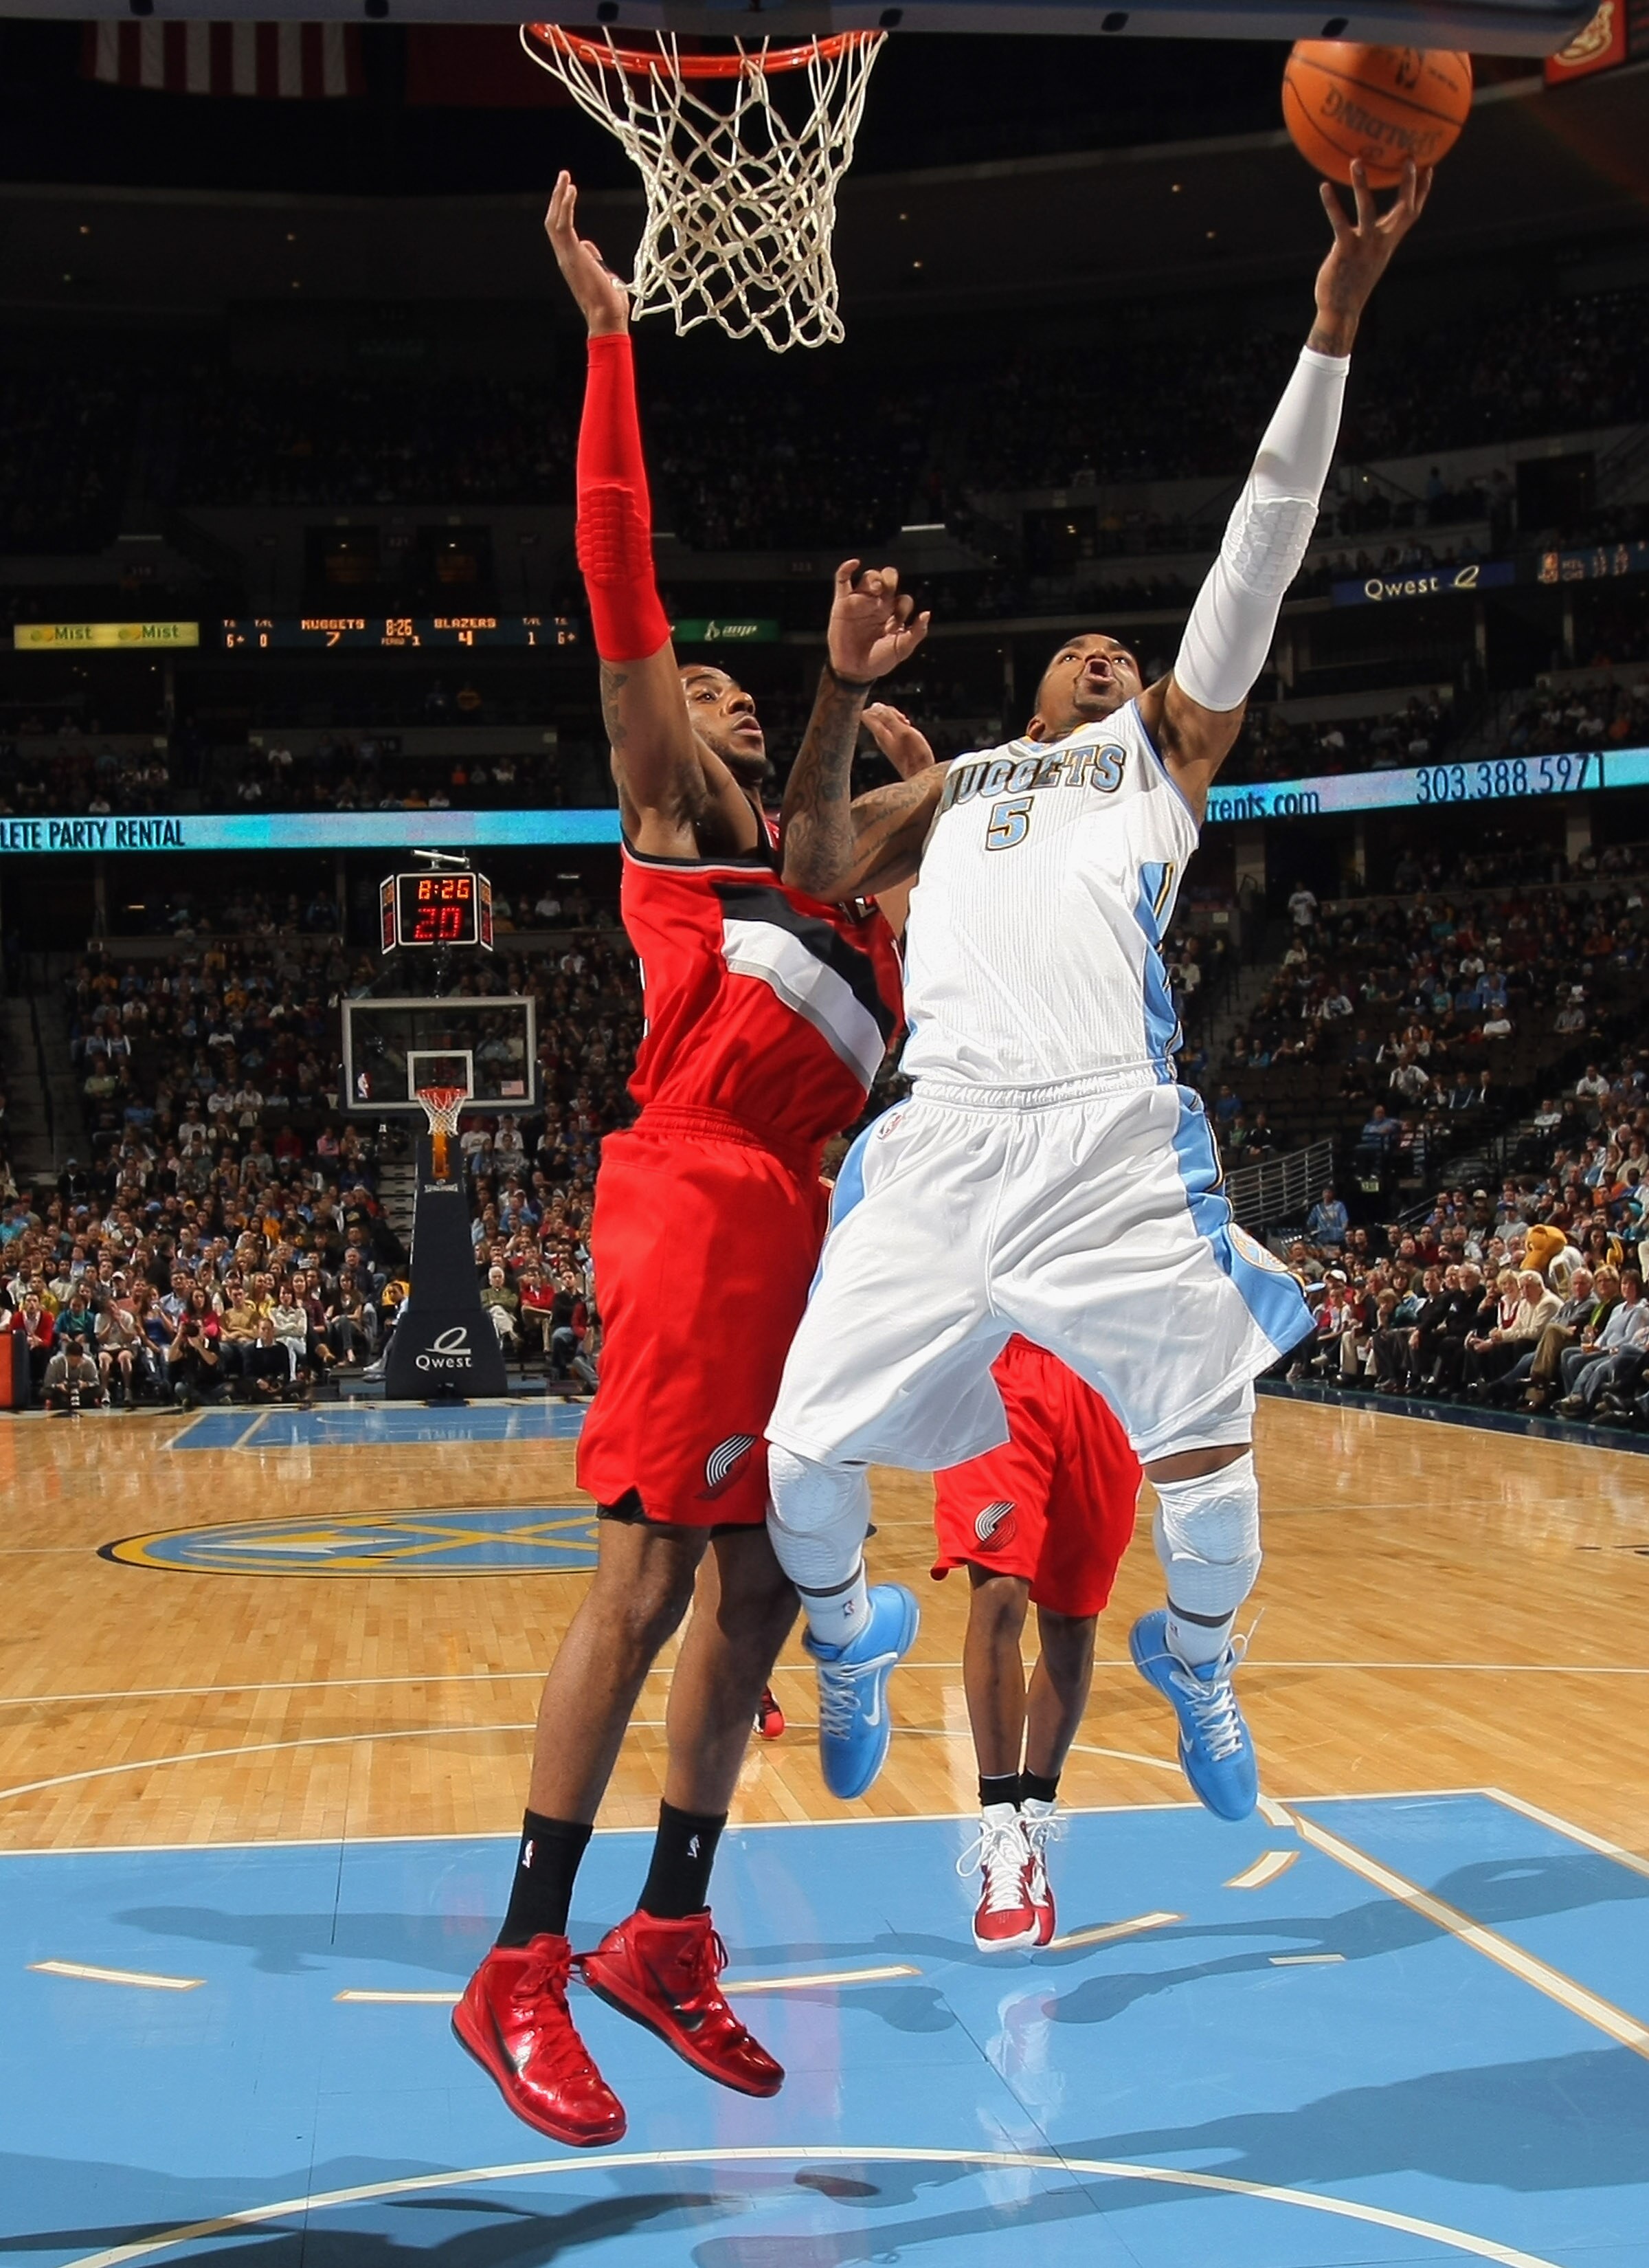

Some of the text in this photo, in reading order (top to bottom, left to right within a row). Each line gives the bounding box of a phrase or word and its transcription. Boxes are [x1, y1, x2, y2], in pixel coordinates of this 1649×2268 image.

[1364, 577, 1440, 601] Qwest
[142, 625, 179, 638] Mist
[301, 619, 365, 630] NUGGETS
[385, 619, 412, 636] 8:26
[434, 618, 497, 629] BLAZERS
[55, 626, 92, 640] Mist
[260, 633, 267, 647] 0
[326, 632, 340, 647] 7
[412, 636, 420, 646] 1
[458, 630, 473, 646] 4
[528, 632, 536, 645] 1
[1416, 753, 1605, 804] 303.388.5971
[1207, 791, 1320, 822] rents.com
[985, 796, 1035, 852] 5
[49, 820, 107, 849] PARTY
[115, 819, 186, 848] RENTAL
[418, 880, 470, 900] 8:26
[414, 907, 462, 939] 20
[415, 1355, 473, 1371] Qwest
